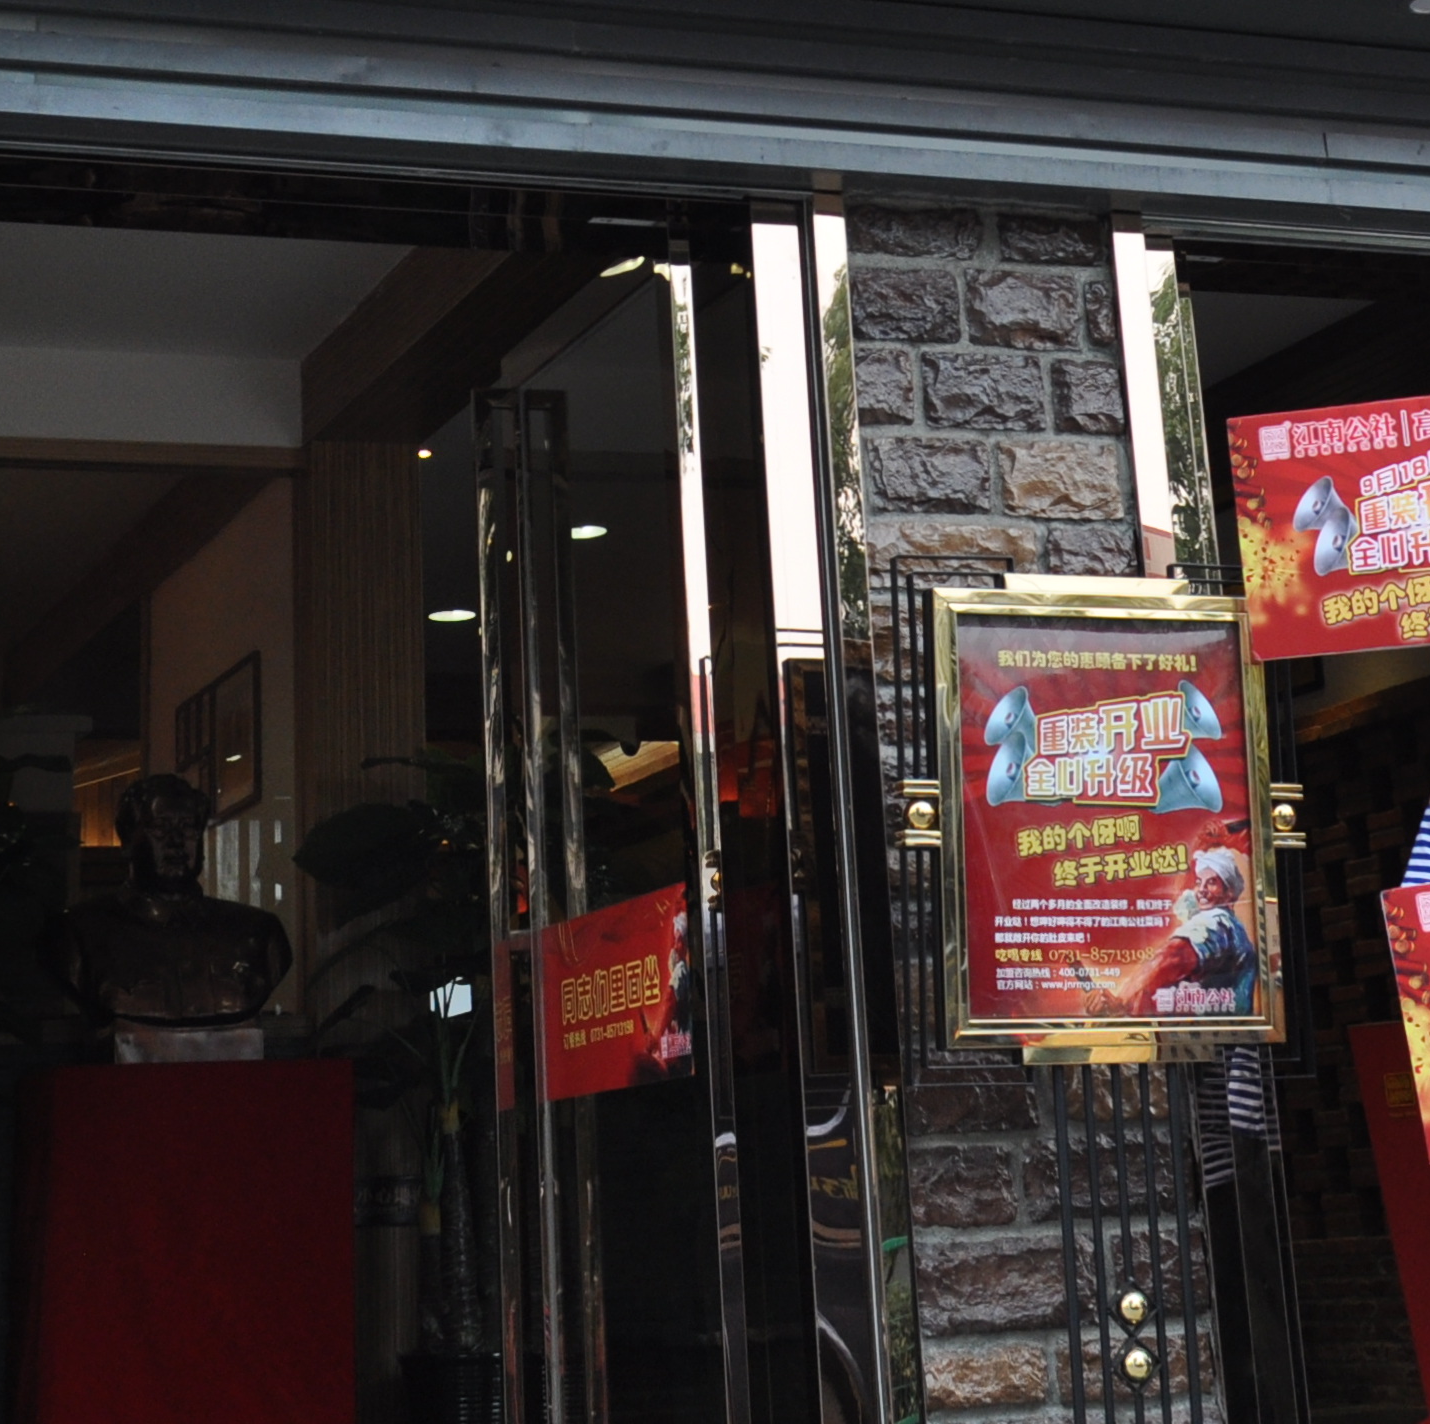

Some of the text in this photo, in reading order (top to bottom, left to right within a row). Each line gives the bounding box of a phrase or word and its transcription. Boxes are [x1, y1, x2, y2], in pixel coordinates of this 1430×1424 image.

[1293, 412, 1397, 446] 江南公社
[1041, 696, 1184, 755] 重装开业
[561, 955, 661, 1025] 同志们里面坐
